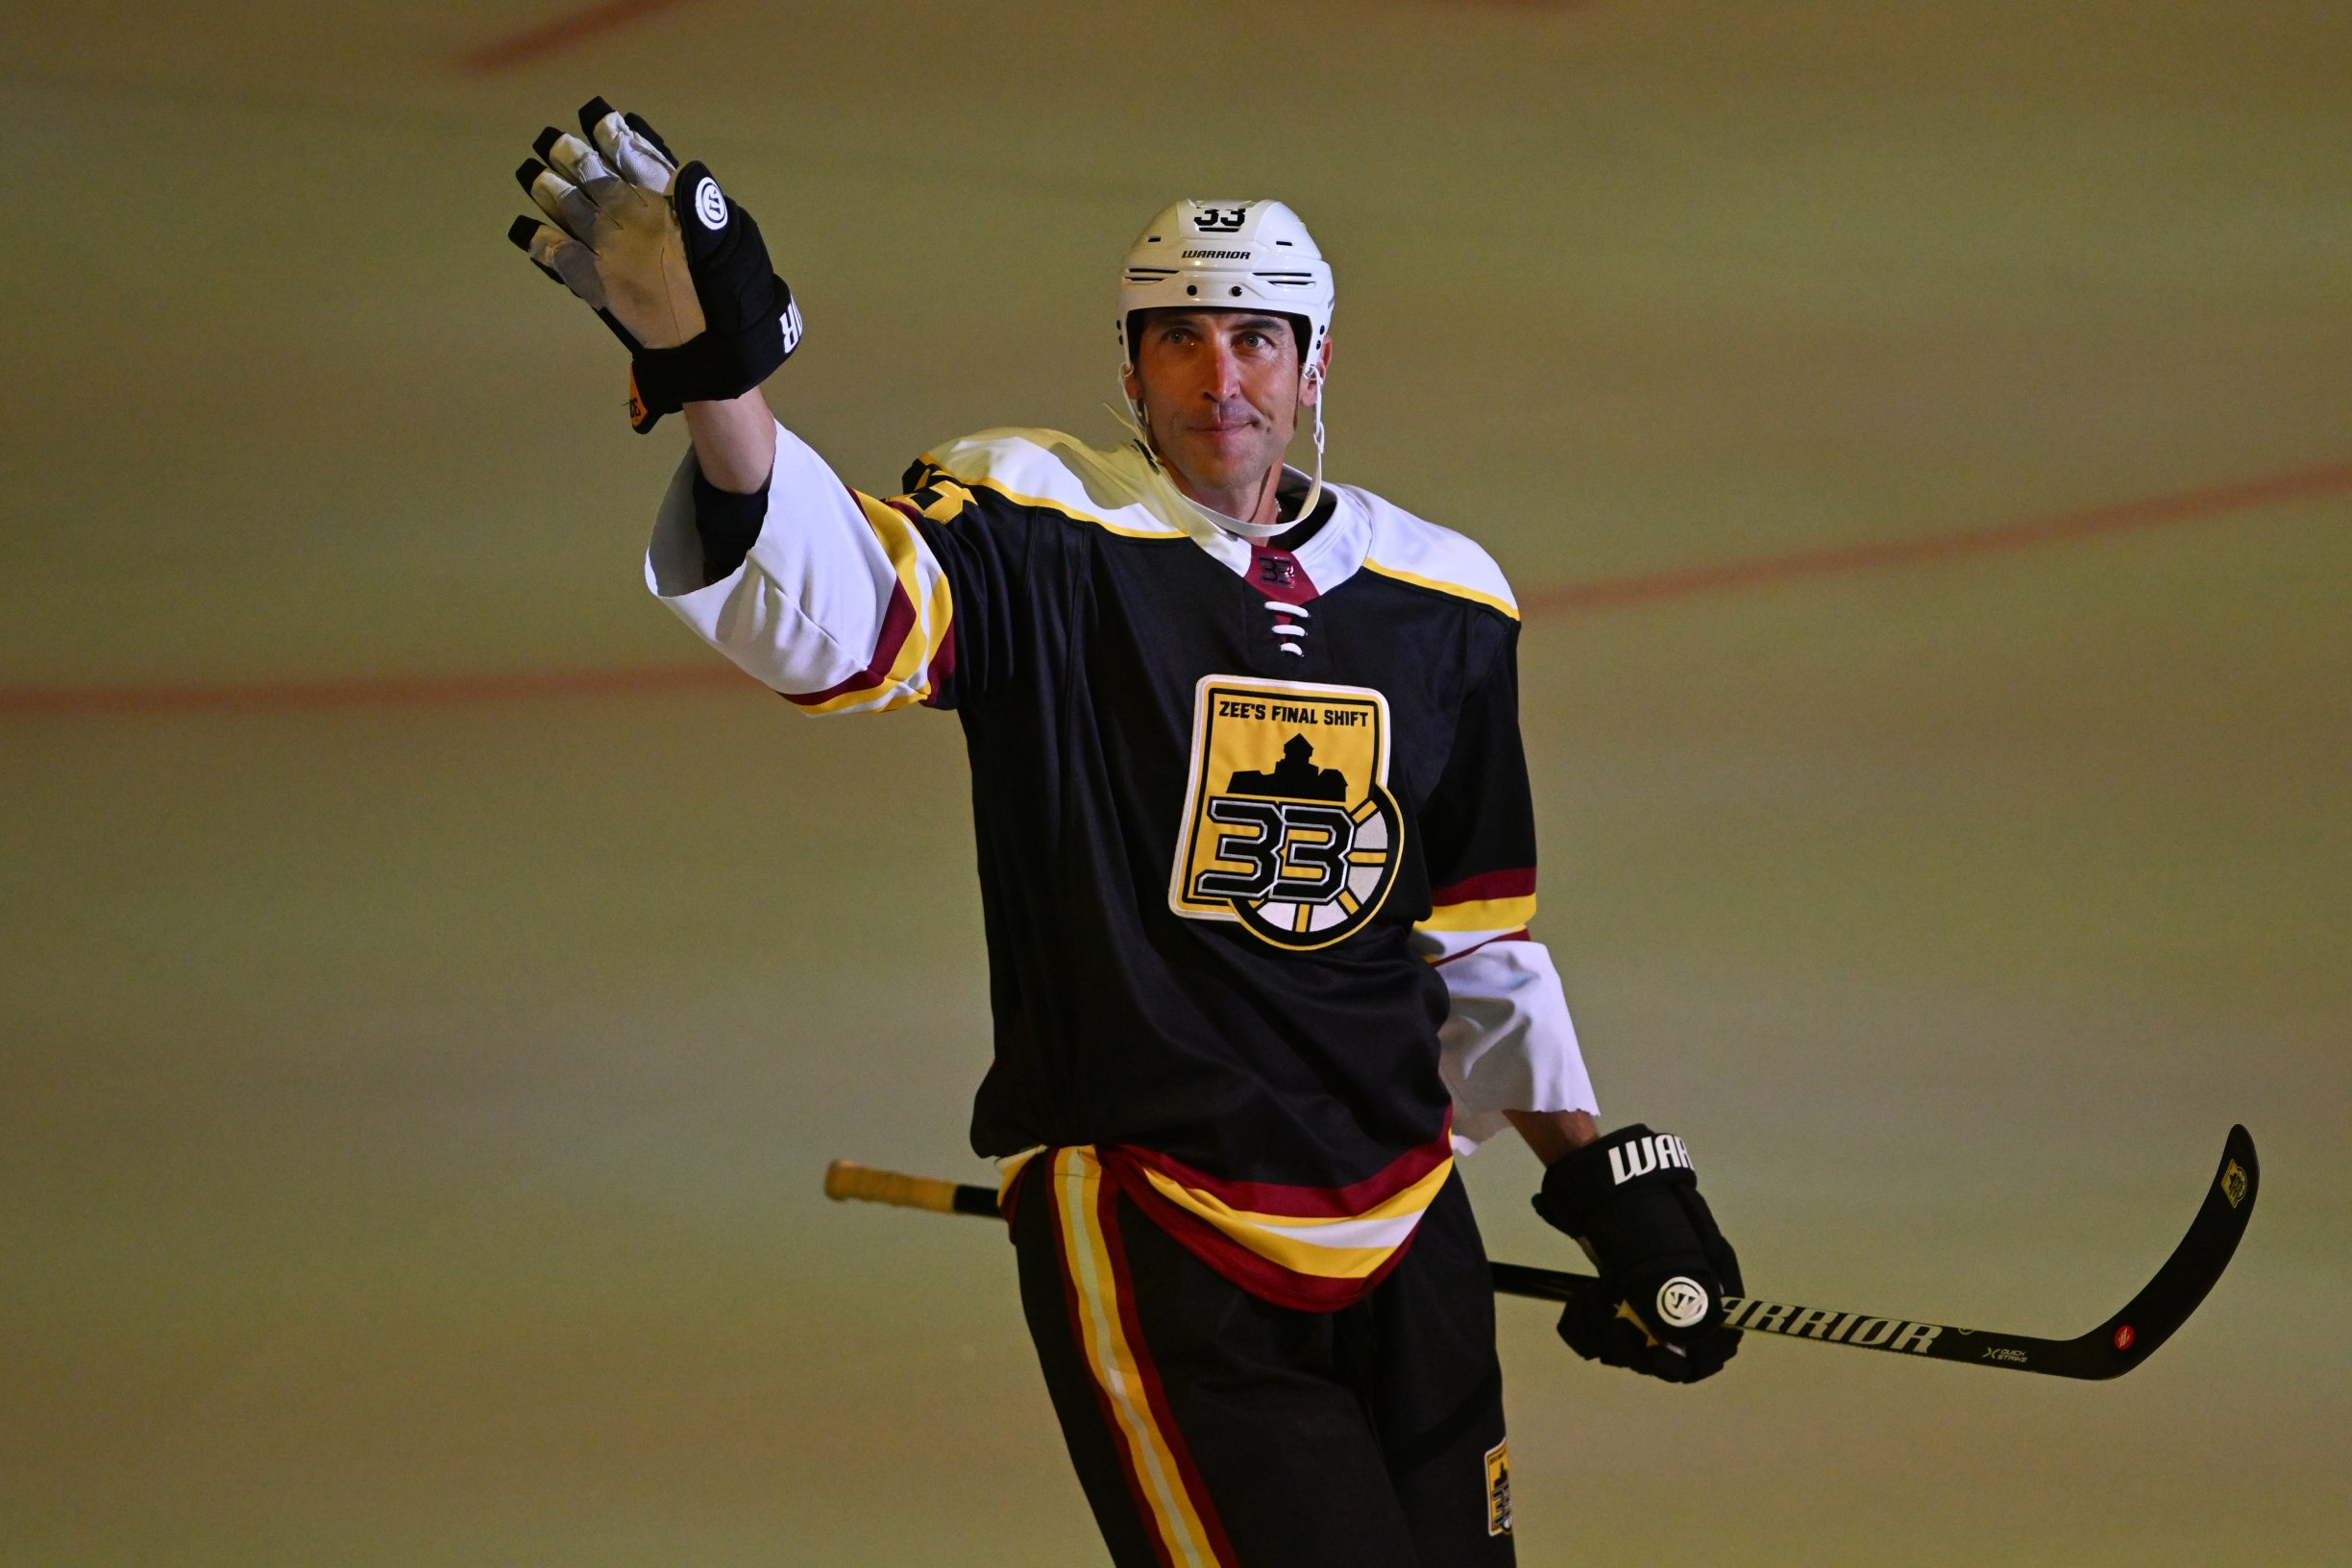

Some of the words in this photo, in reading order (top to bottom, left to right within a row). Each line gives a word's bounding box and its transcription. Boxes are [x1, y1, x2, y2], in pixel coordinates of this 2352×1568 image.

[1193, 208, 1246, 227] 33
[1182, 250, 1251, 260] WARRIOR
[1219, 700, 1266, 720] ZEE'S
[1271, 705, 1318, 724] FINAL
[1324, 709, 1368, 726] SHIFT
[1193, 796, 1360, 906] 33
